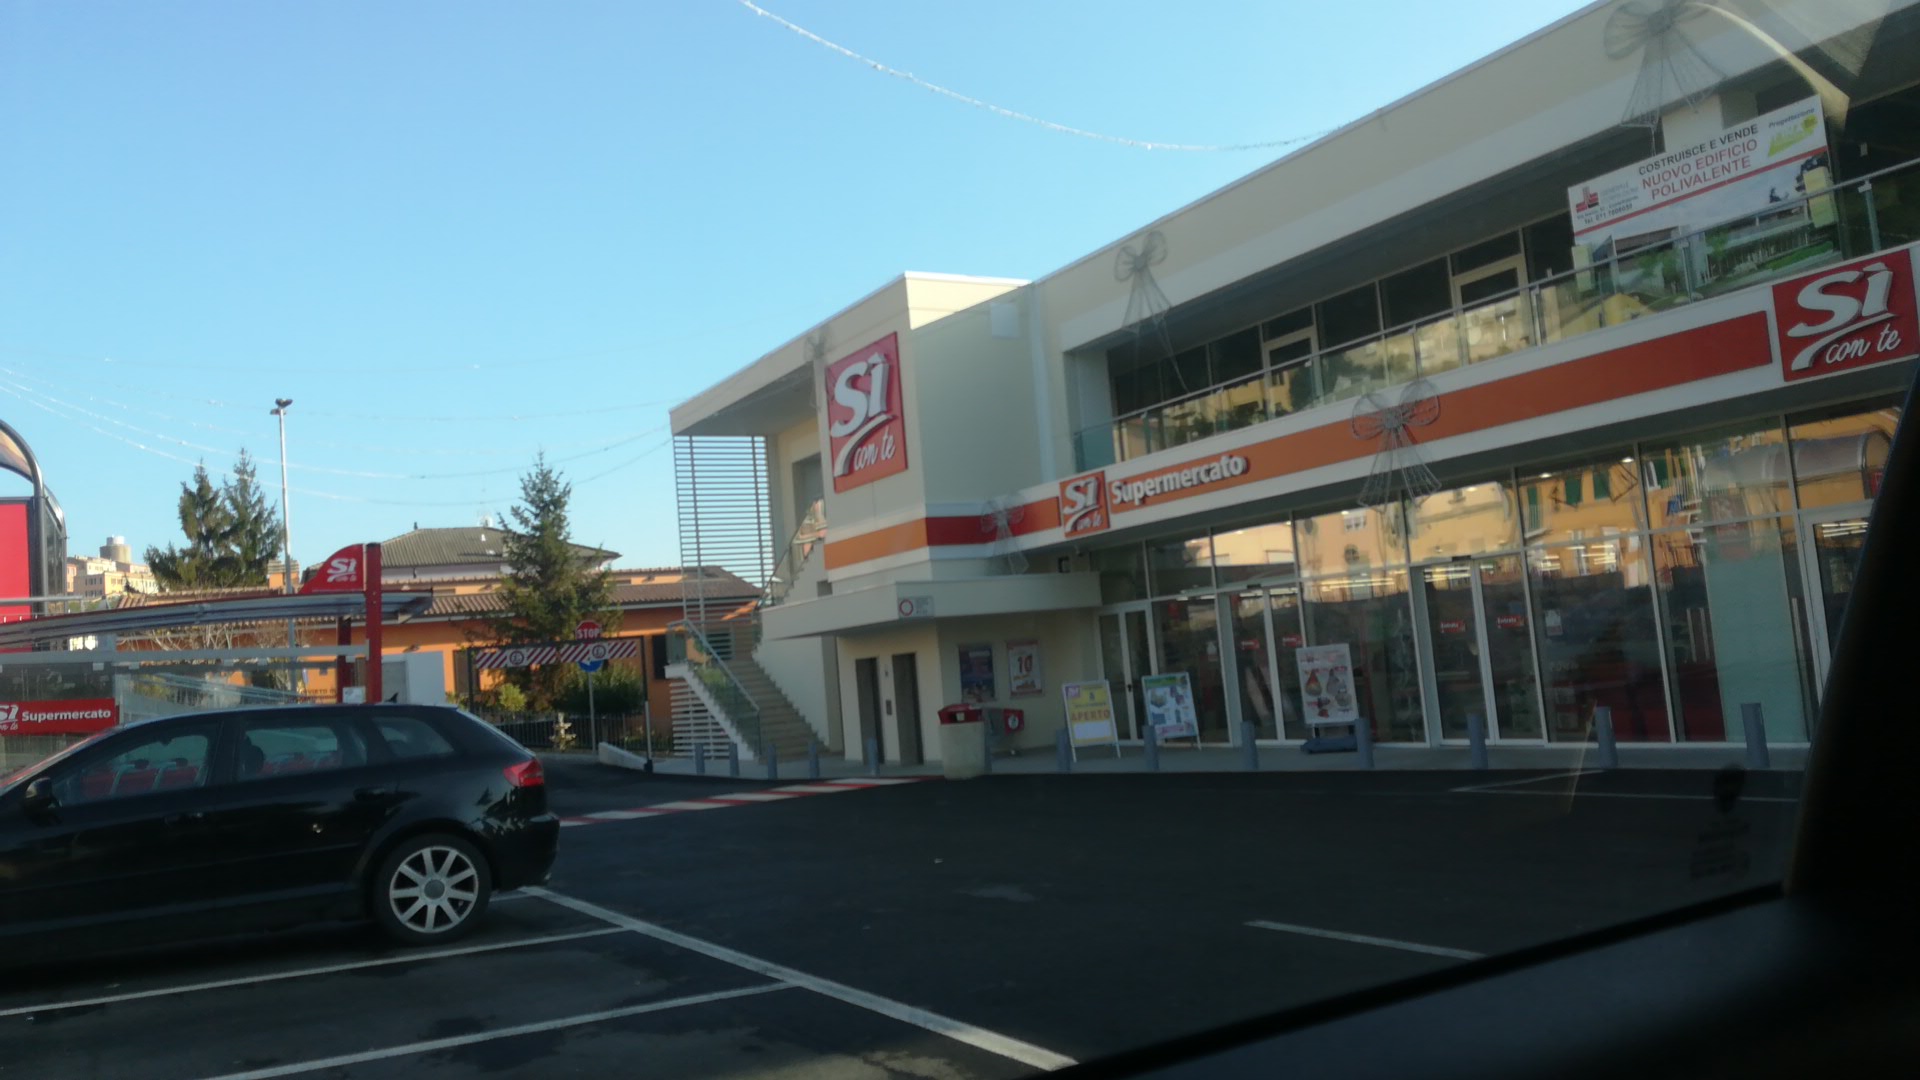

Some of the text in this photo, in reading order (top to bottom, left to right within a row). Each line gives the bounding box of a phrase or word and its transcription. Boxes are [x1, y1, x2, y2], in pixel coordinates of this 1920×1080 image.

[1639, 143, 1706, 176] COSTRUISCE
[1709, 139, 1717, 149] E
[1719, 124, 1759, 145] VENDE
[1642, 162, 1692, 190] NUOVO
[1695, 138, 1758, 171] EDIFICIO
[1651, 156, 1752, 200] POLIVALENTE
[1825, 323, 1901, 364] con te
[854, 425, 896, 471] con te
[1111, 455, 1249, 505] Supermercato
[577, 629, 601, 639] STOP
[21, 709, 111, 723] Supermercato
